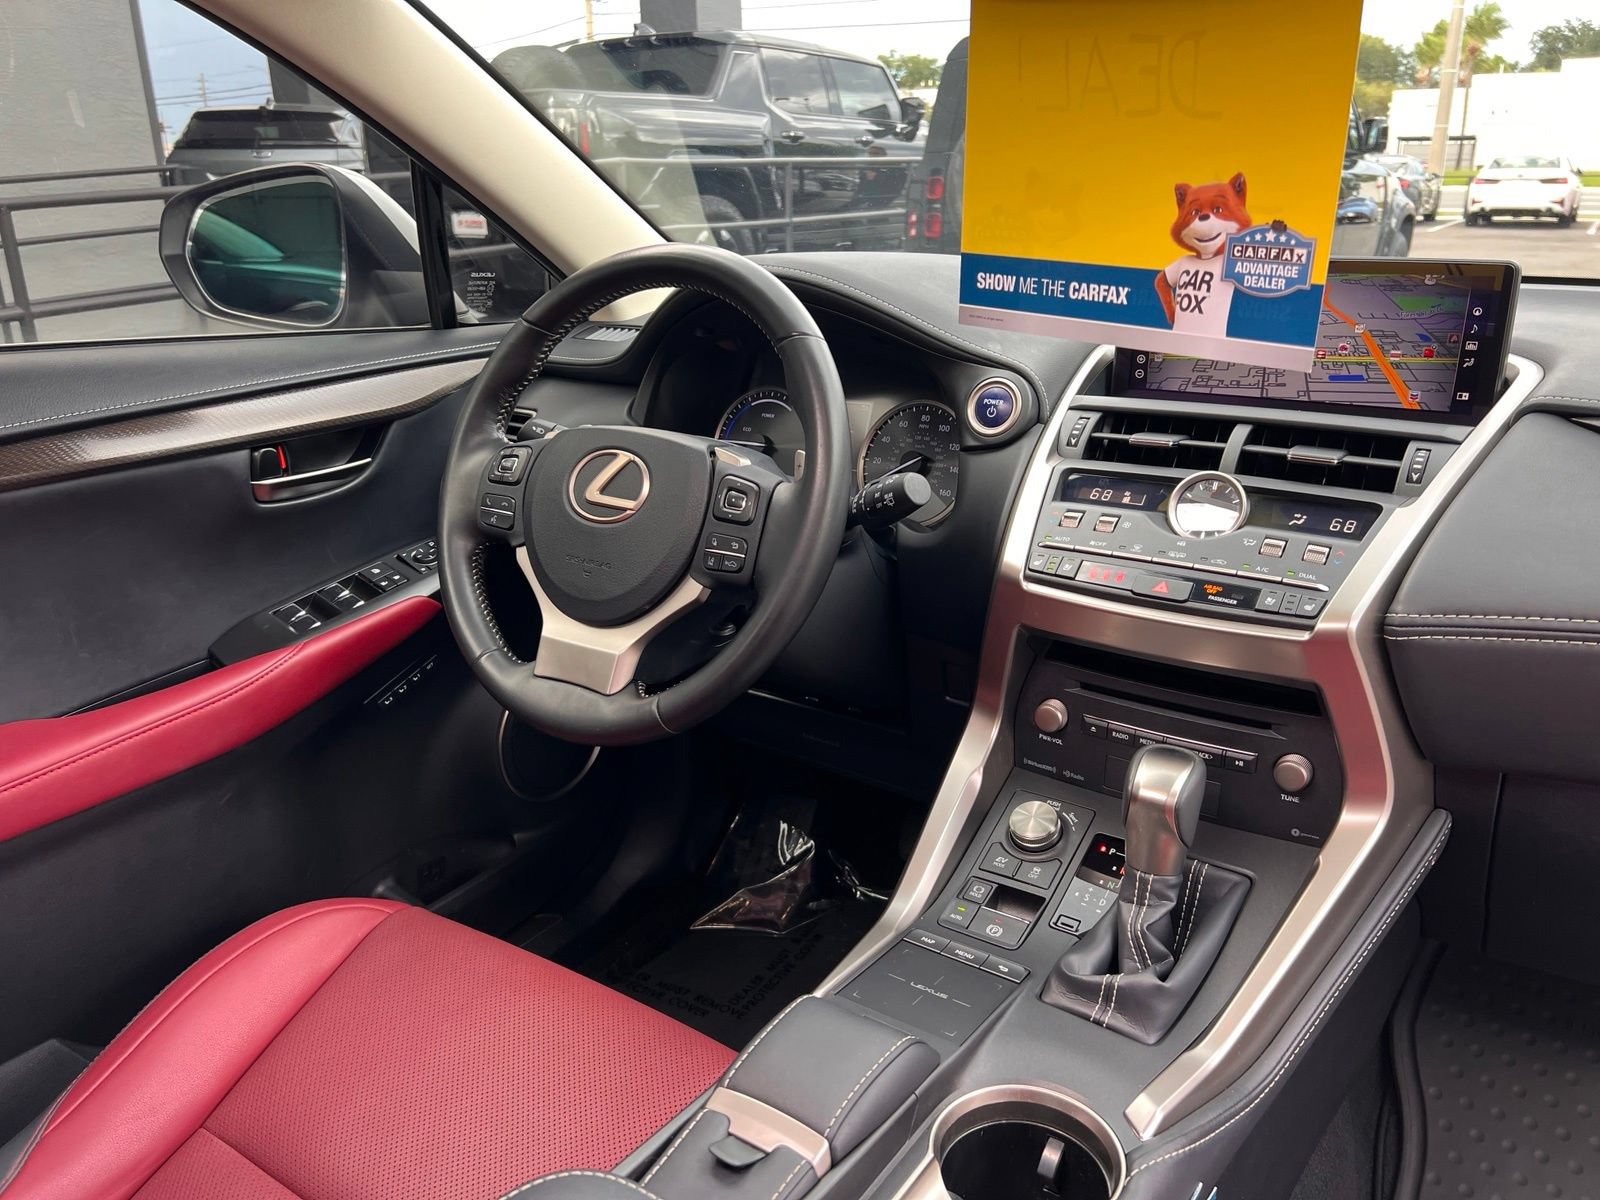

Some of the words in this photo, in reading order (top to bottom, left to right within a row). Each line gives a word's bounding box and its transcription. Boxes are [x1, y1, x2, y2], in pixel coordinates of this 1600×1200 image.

[1233, 244, 1305, 263] CARFAX
[1235, 261, 1299, 278] ADVANTAGE
[1178, 269, 1214, 293] CAR
[1244, 275, 1286, 290] DEALER
[977, 272, 1015, 292] SHOW
[1019, 277, 1038, 295] ME
[1042, 278, 1066, 298] THE
[1069, 282, 1129, 305] CARFAX
[949, 443, 960, 451] 120
[939, 489, 951, 497] 160
[1089, 488, 1113, 501] 68
[1329, 518, 1357, 533] 68
[1299, 572, 1317, 581] DUAL
[1207, 595, 1238, 605] PASSENGER
[1112, 731, 1129, 740] RADIO
[1280, 793, 1300, 803] TUNE
[1107, 881, 1116, 889] N
[1083, 893, 1090, 901] S
[920, 936, 936, 944] MAP
[954, 949, 975, 960] MENU
[909, 981, 949, 999] LEXUS
